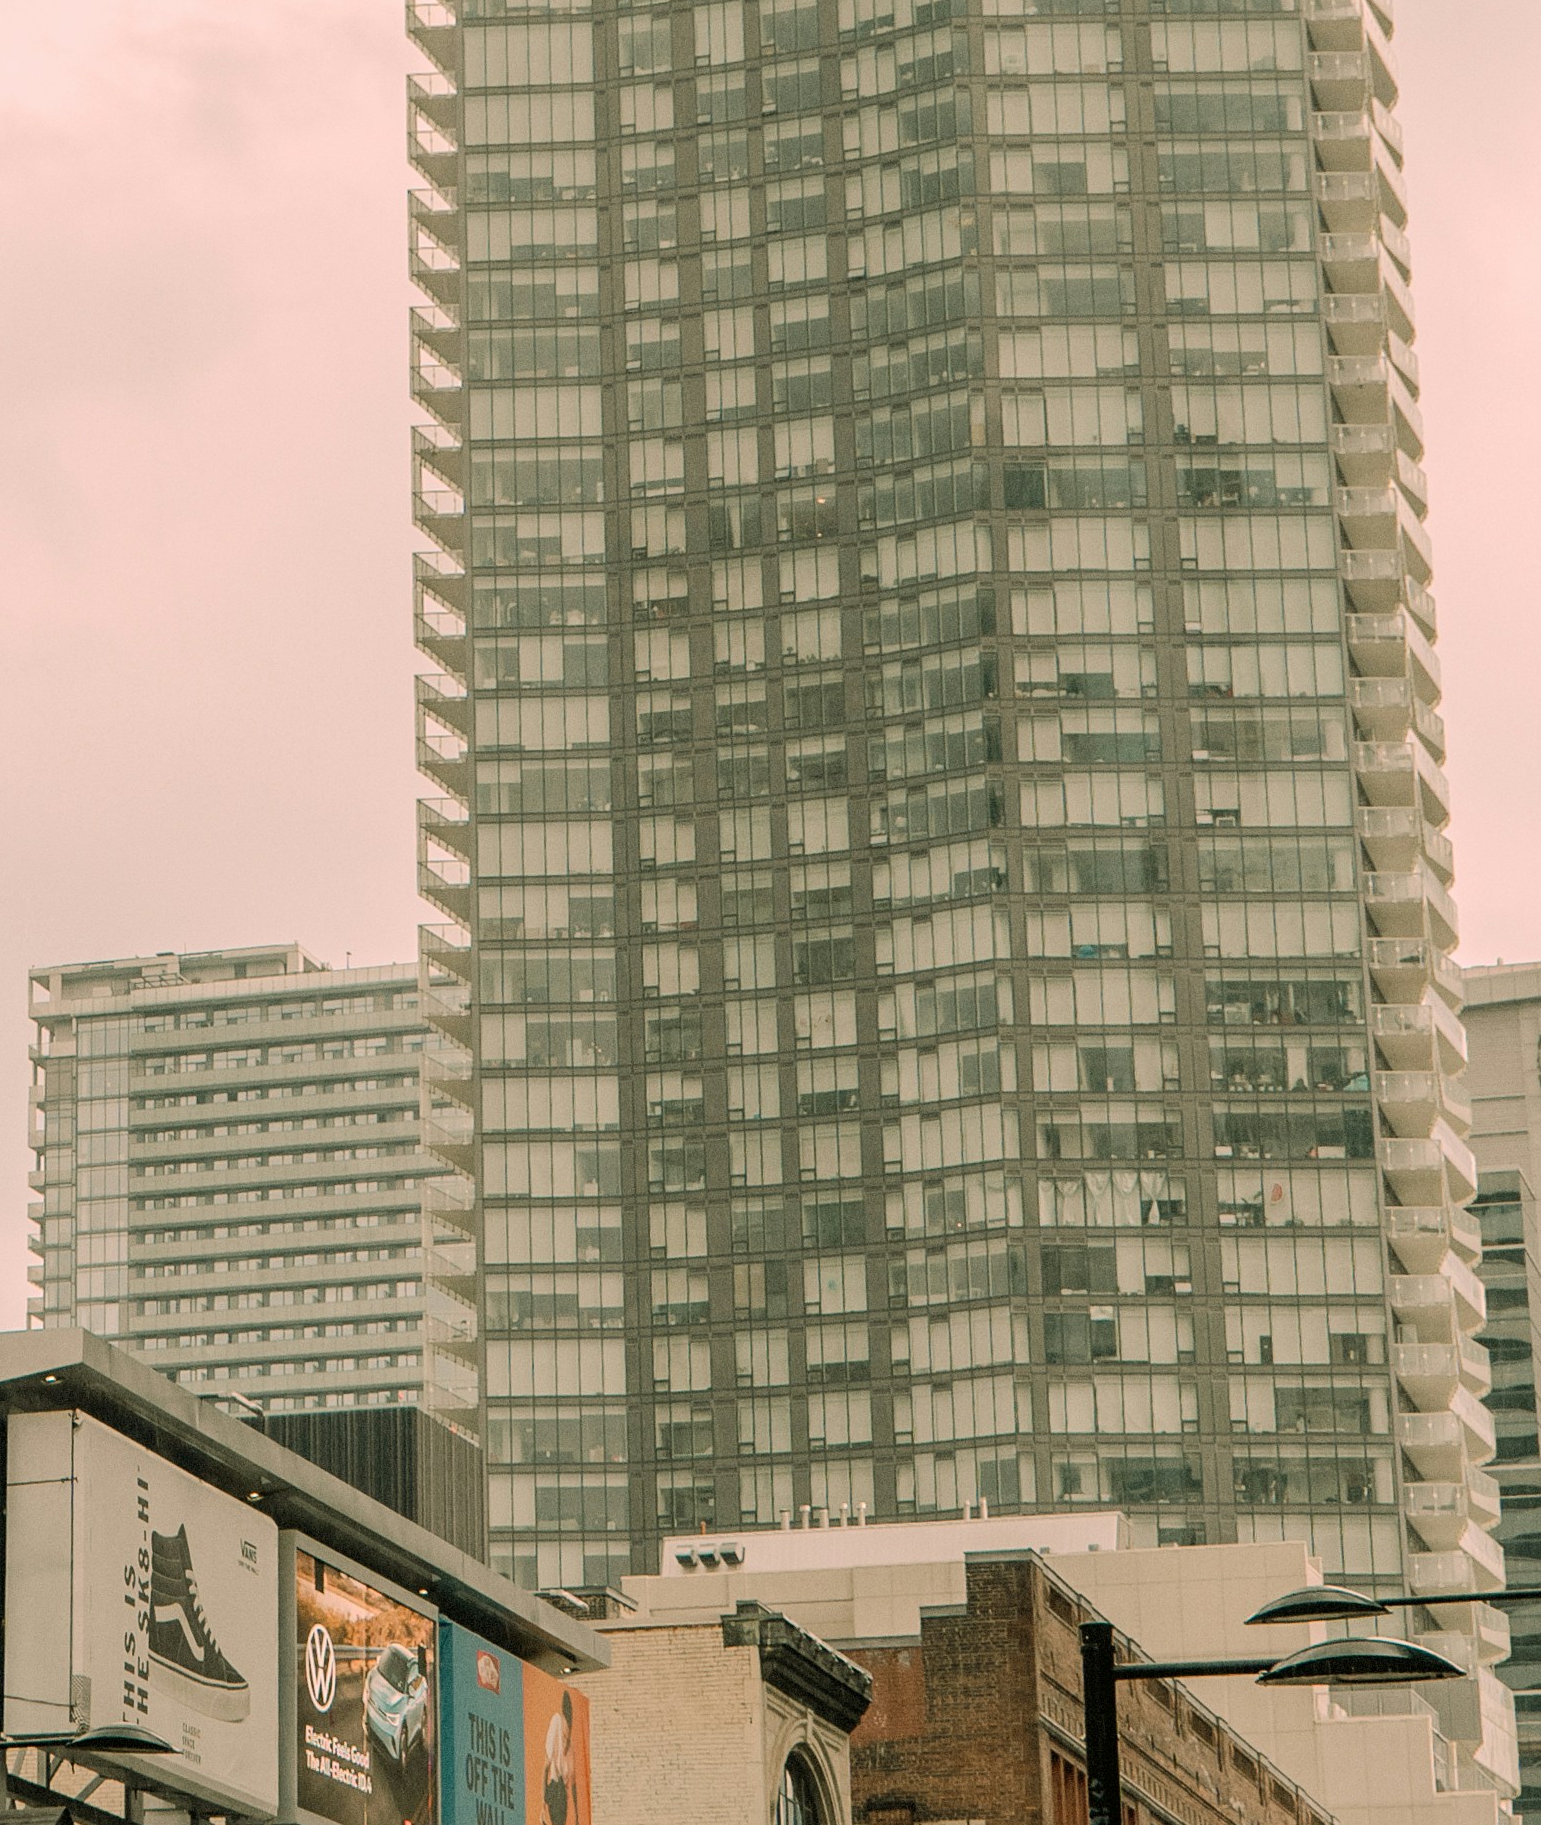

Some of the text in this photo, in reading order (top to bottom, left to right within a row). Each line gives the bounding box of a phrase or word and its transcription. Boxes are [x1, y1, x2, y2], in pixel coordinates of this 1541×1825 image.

[240, 1537, 257, 1564] VANS
[305, 1724, 370, 1769] Electric Feels Good
[468, 1712, 511, 1767] THIS IS
[305, 1749, 320, 1772] The
[320, 1756, 358, 1789] All-Electric
[465, 1753, 515, 1811] OFF THE
